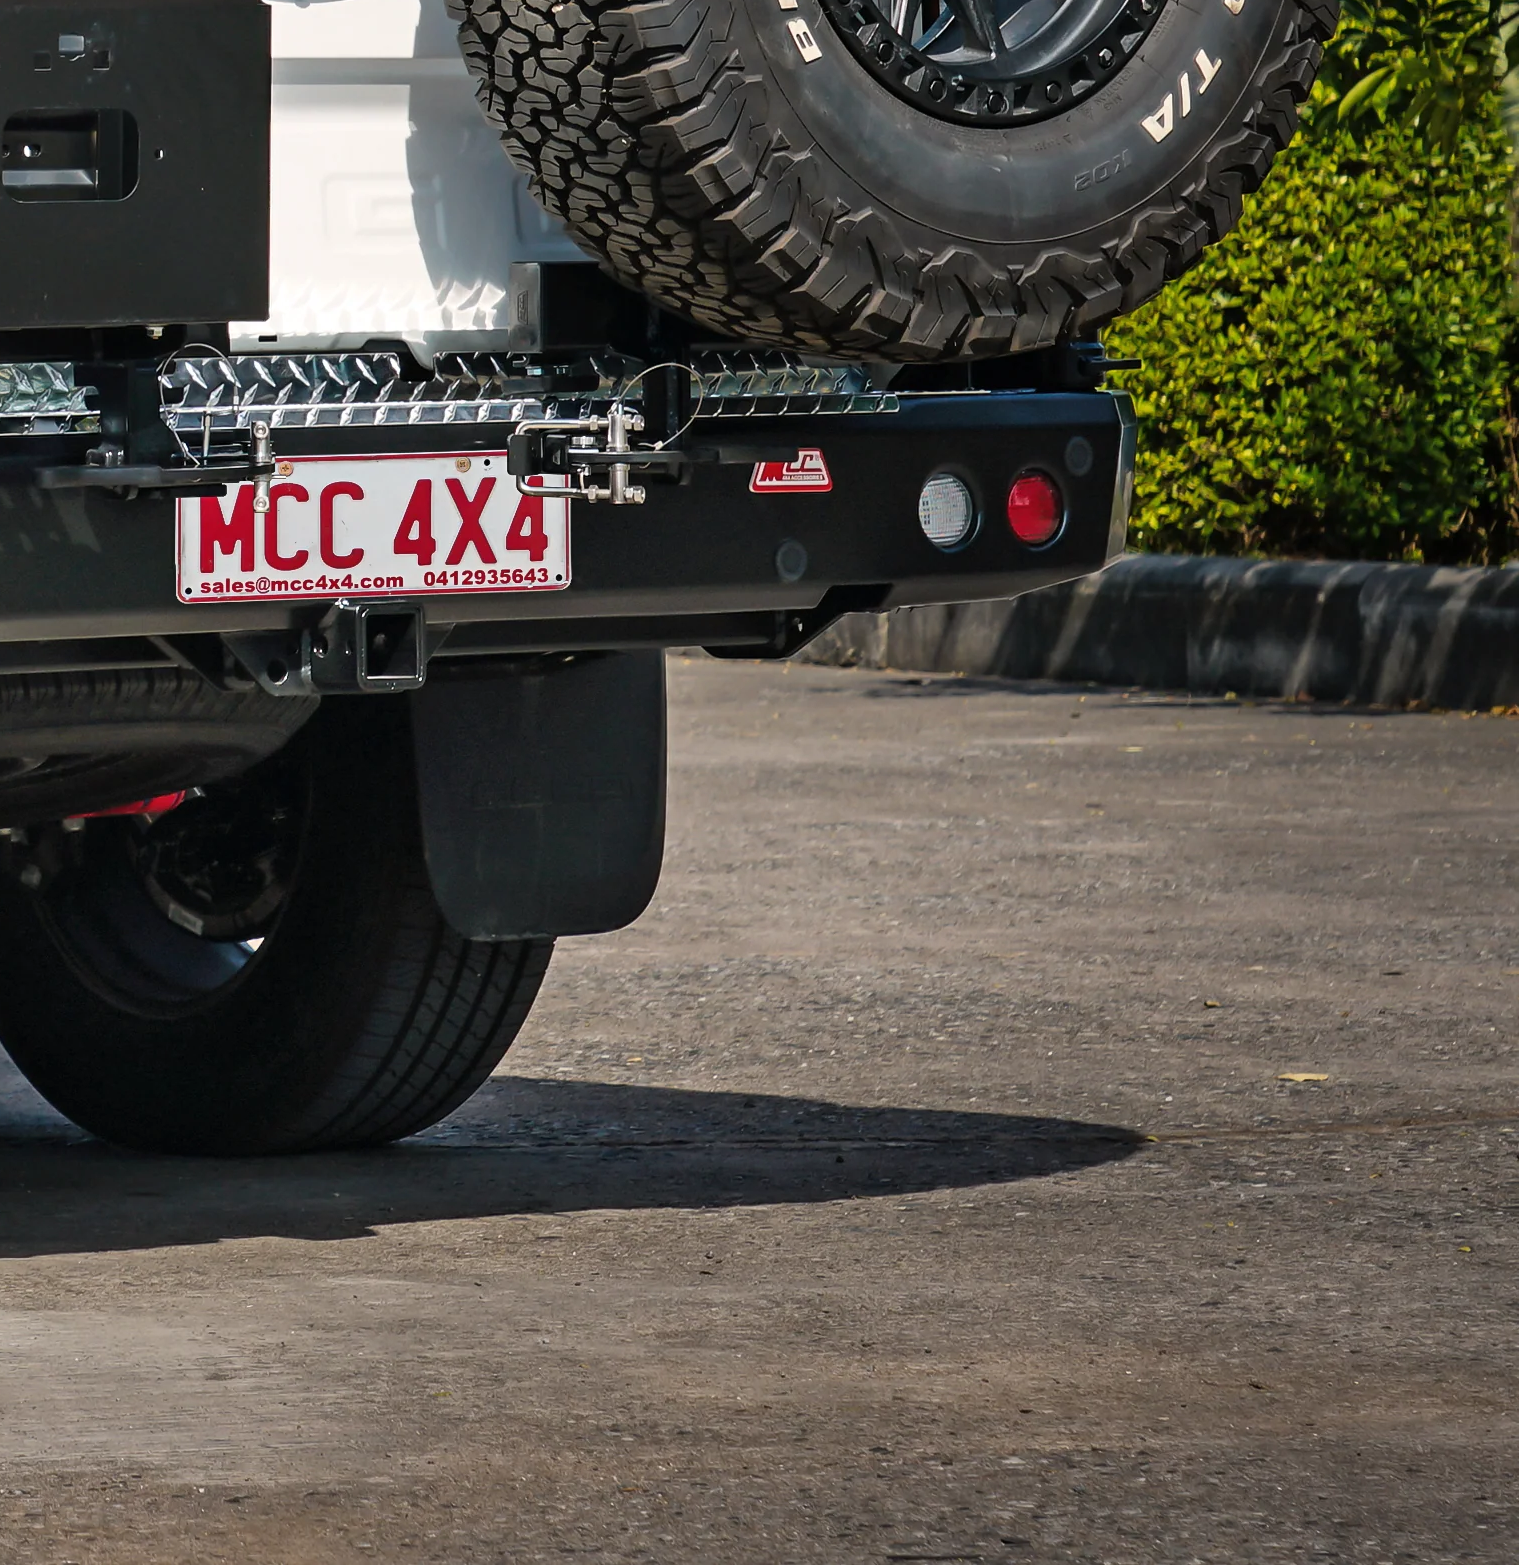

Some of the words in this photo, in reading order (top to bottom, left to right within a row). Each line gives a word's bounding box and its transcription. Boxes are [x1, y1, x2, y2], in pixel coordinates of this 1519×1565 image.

[1139, 47, 1223, 144] T/A
[1073, 148, 1132, 191] KO2
[200, 481, 364, 573] MCC
[393, 475, 549, 566] 4X4
[200, 573, 404, 594] sales@mcc4x4.com
[423, 567, 549, 588] 0412935643
